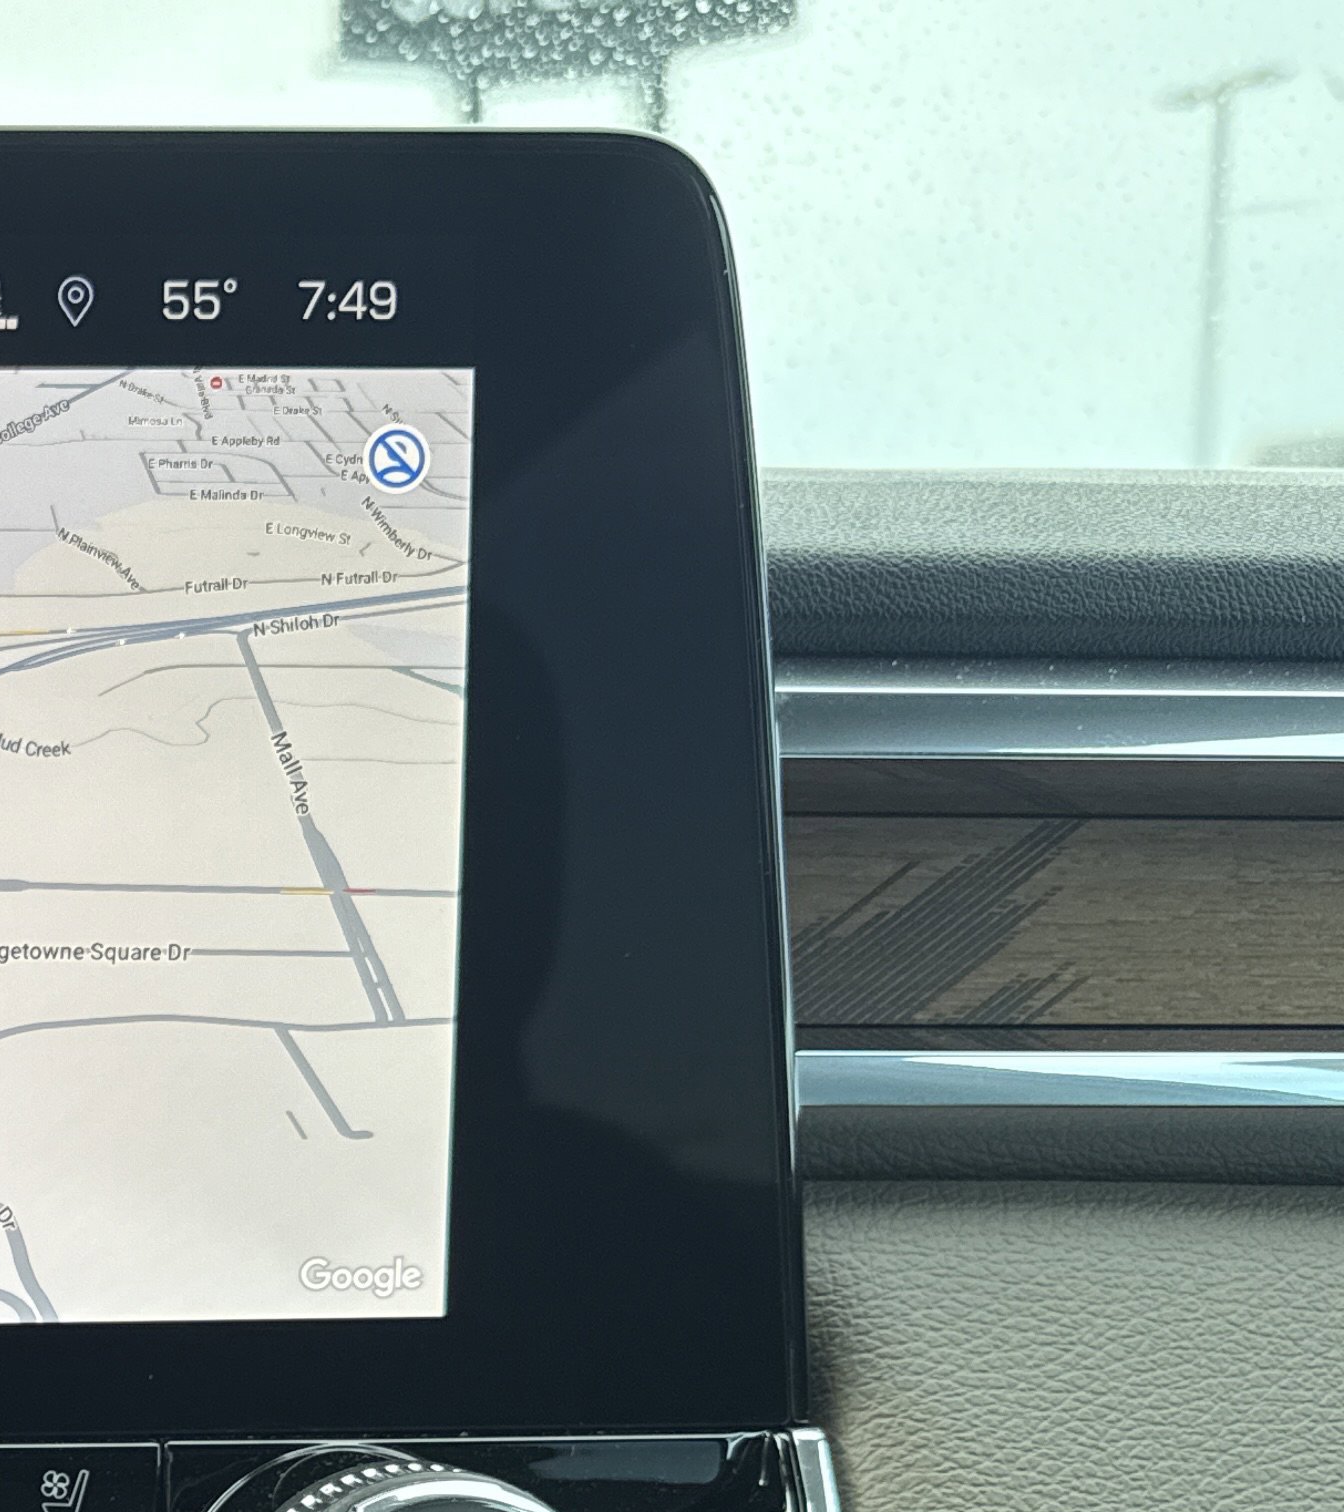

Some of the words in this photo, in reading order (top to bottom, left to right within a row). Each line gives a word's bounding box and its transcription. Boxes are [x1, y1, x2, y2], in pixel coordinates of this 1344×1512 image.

[162, 278, 237, 320] 55°
[298, 281, 398, 320] 7:49
[40, 399, 70, 421] Ave
[265, 523, 273, 534] E
[276, 523, 335, 543] Longview
[338, 533, 351, 545] St
[361, 496, 374, 511] N
[370, 508, 415, 558] Wimberly
[417, 548, 433, 560] Dr
[57, 527, 71, 542] N
[68, 536, 121, 570] Plainview
[119, 566, 141, 591] Ave
[185, 579, 229, 594] Futrall
[232, 578, 248, 590] Dr
[321, 573, 332, 585] N
[336, 573, 378, 586] Futrall
[381, 572, 398, 584] Dr
[253, 623, 265, 636] N
[270, 615, 318, 634] Shiloh
[322, 614, 340, 628] Dr
[25, 741, 71, 757] Creek
[271, 731, 302, 777] Mall
[290, 781, 309, 816] Ave
[90, 943, 161, 965] Square
[168, 945, 191, 961] Dr
[300, 1256, 423, 1298] Google
